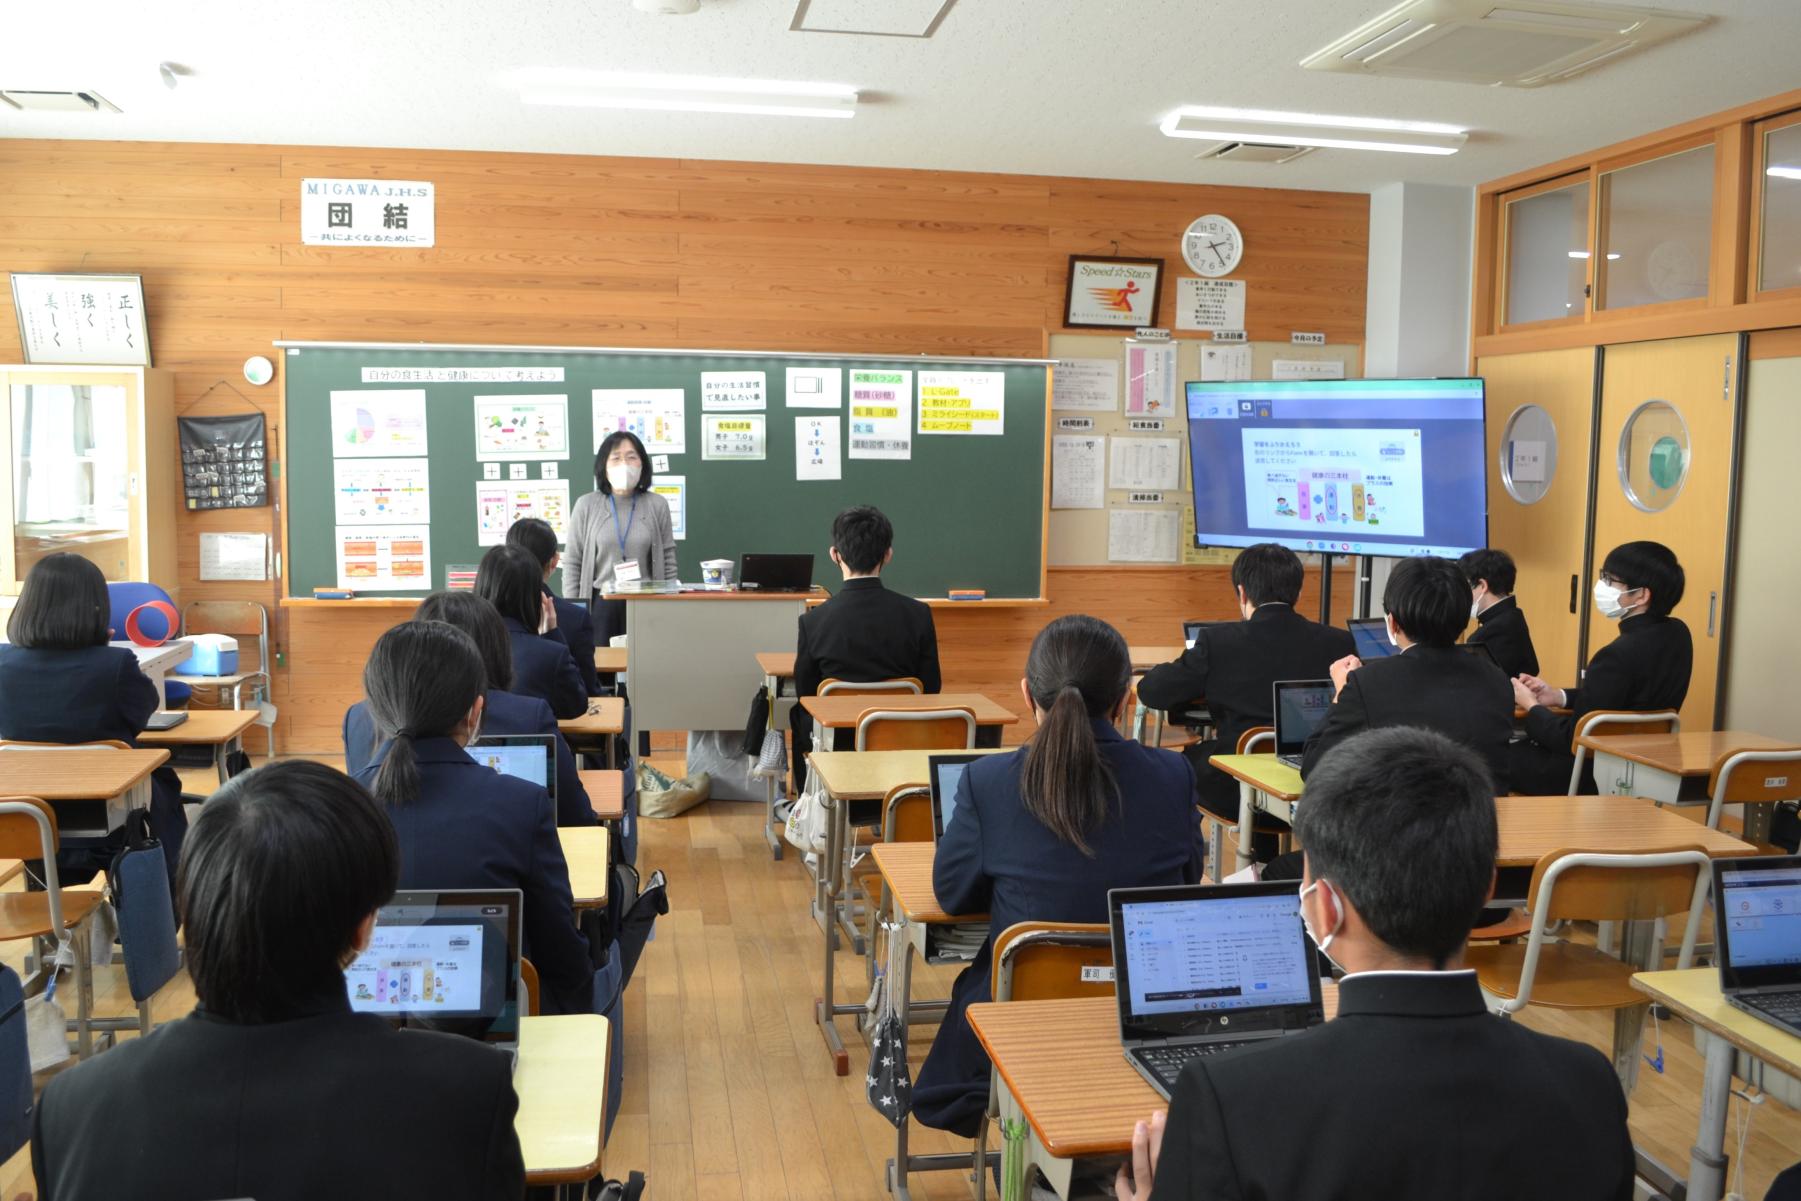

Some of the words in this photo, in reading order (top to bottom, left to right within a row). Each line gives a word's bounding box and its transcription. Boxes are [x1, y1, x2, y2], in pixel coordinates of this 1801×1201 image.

[307, 183, 380, 196] MIGAWA
[384, 187, 428, 197] J.H.S
[327, 202, 410, 229] 団結
[80, 292, 96, 328] 強く
[44, 291, 61, 348] 美しく
[117, 294, 135, 349] 正しく
[1294, 334, 1323, 342] 今月の予定
[369, 370, 557, 381] 自分の食生活と健康について考えよう
[854, 373, 903, 384] 栄養バランス
[706, 381, 760, 389] 自分の生活習慣
[706, 393, 761, 401] で見直したい事
[852, 440, 909, 450] 運動習慣・休養
